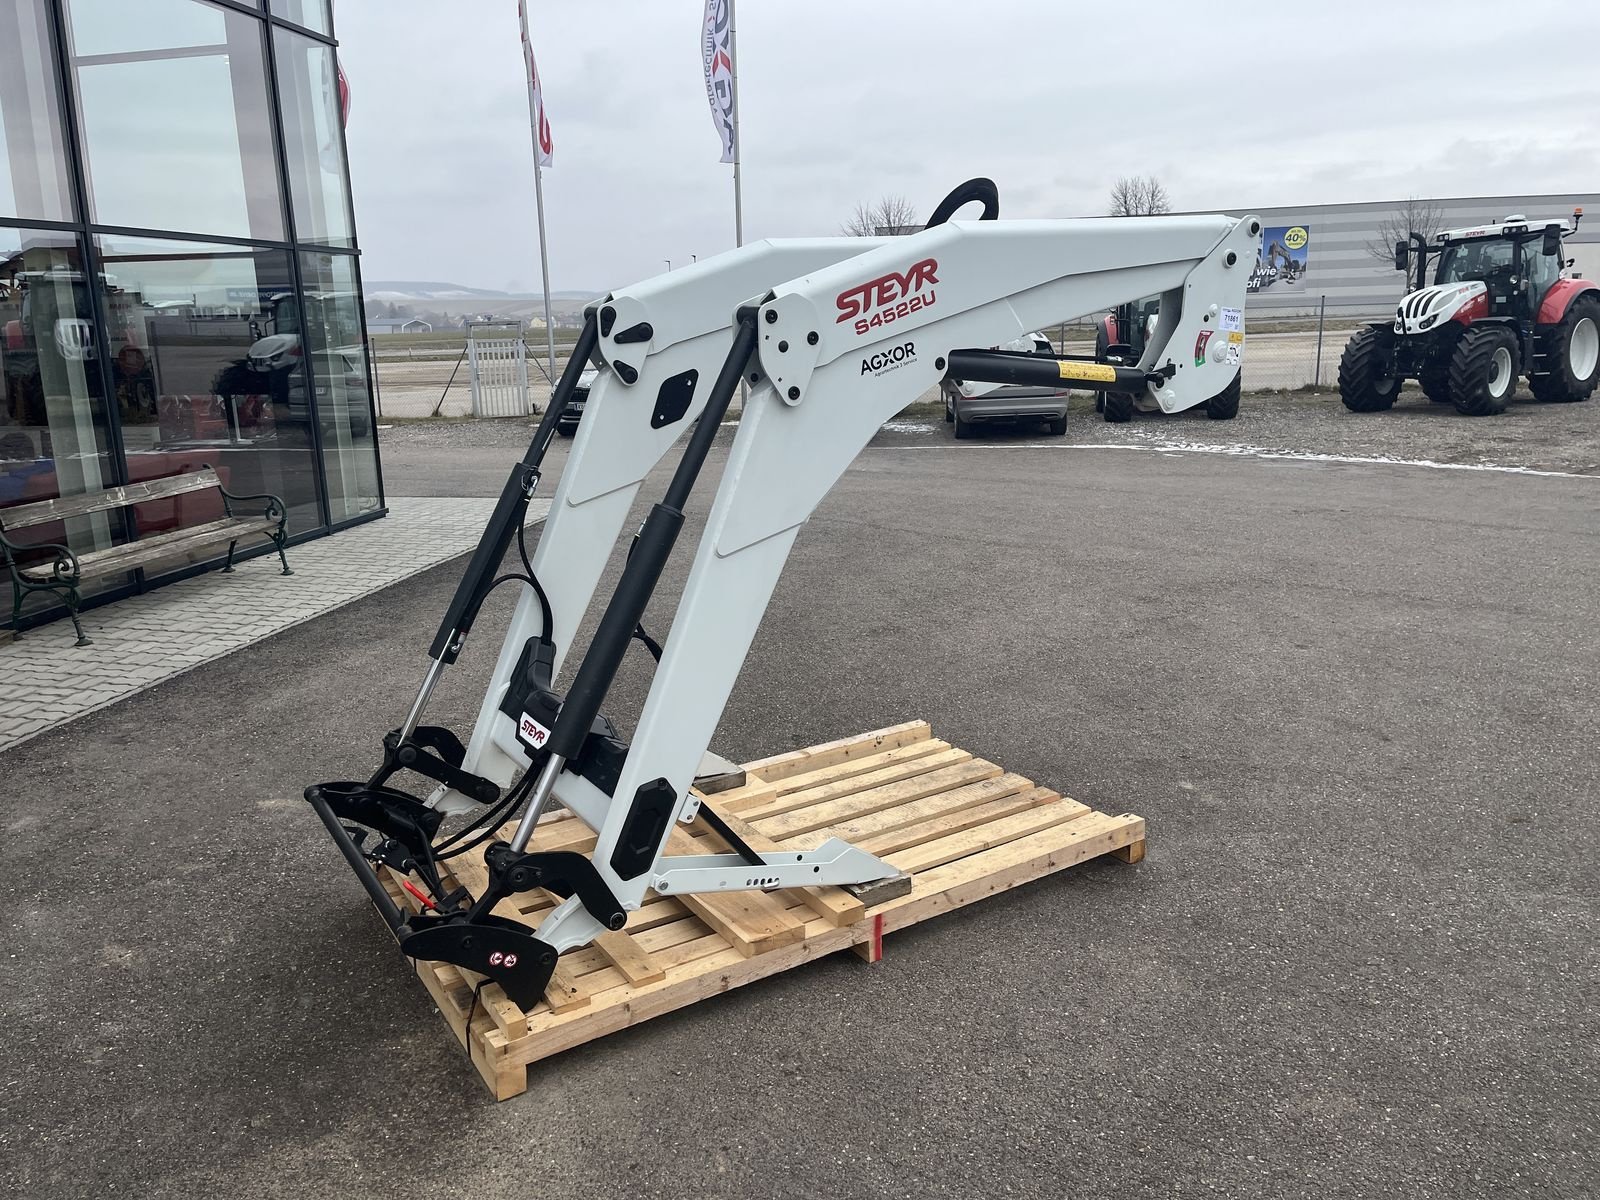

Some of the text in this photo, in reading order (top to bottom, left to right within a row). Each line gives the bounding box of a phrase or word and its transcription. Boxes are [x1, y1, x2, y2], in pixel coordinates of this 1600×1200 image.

[1285, 233, 1306, 242] 40%
[1247, 277, 1261, 288] ofi
[1256, 266, 1277, 276] wie
[836, 258, 939, 324] STEYR
[854, 290, 936, 336] S4522U
[861, 341, 916, 376] AGXOR
[522, 719, 545, 743] STEYR
